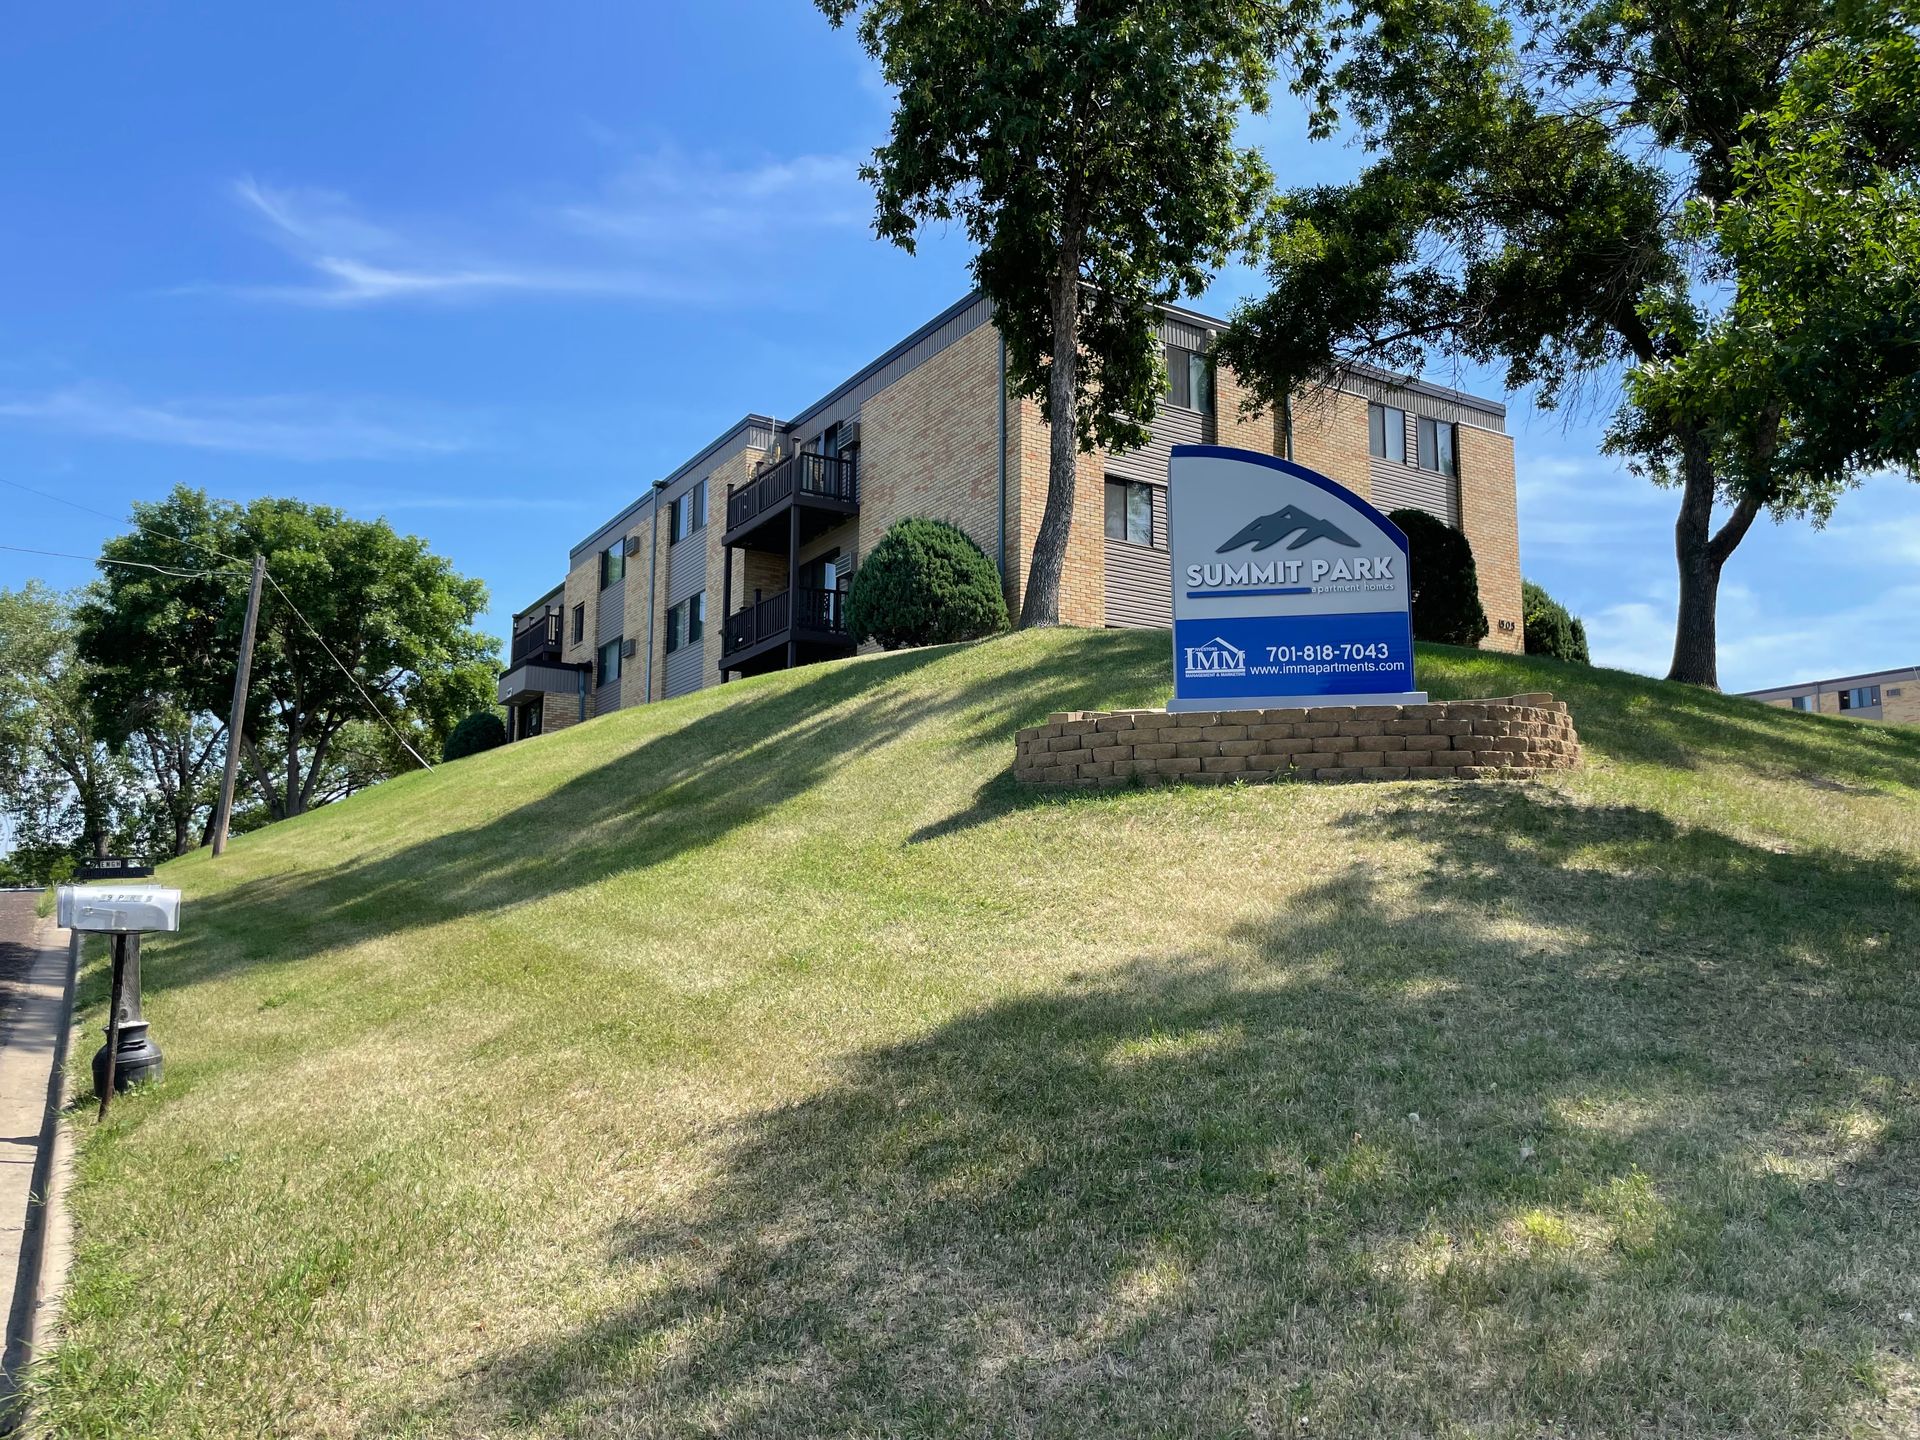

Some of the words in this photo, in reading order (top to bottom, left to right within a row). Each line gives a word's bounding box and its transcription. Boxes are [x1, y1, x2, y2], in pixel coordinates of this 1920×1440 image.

[1186, 560, 1303, 587] SUMMIT
[1311, 556, 1395, 582] PARK
[1311, 584, 1360, 595] apartment
[1364, 581, 1395, 592] homes
[1184, 647, 1246, 670] IMM
[1266, 643, 1389, 662] 701-818-7043
[1250, 661, 1405, 676] www.immapartments.com
